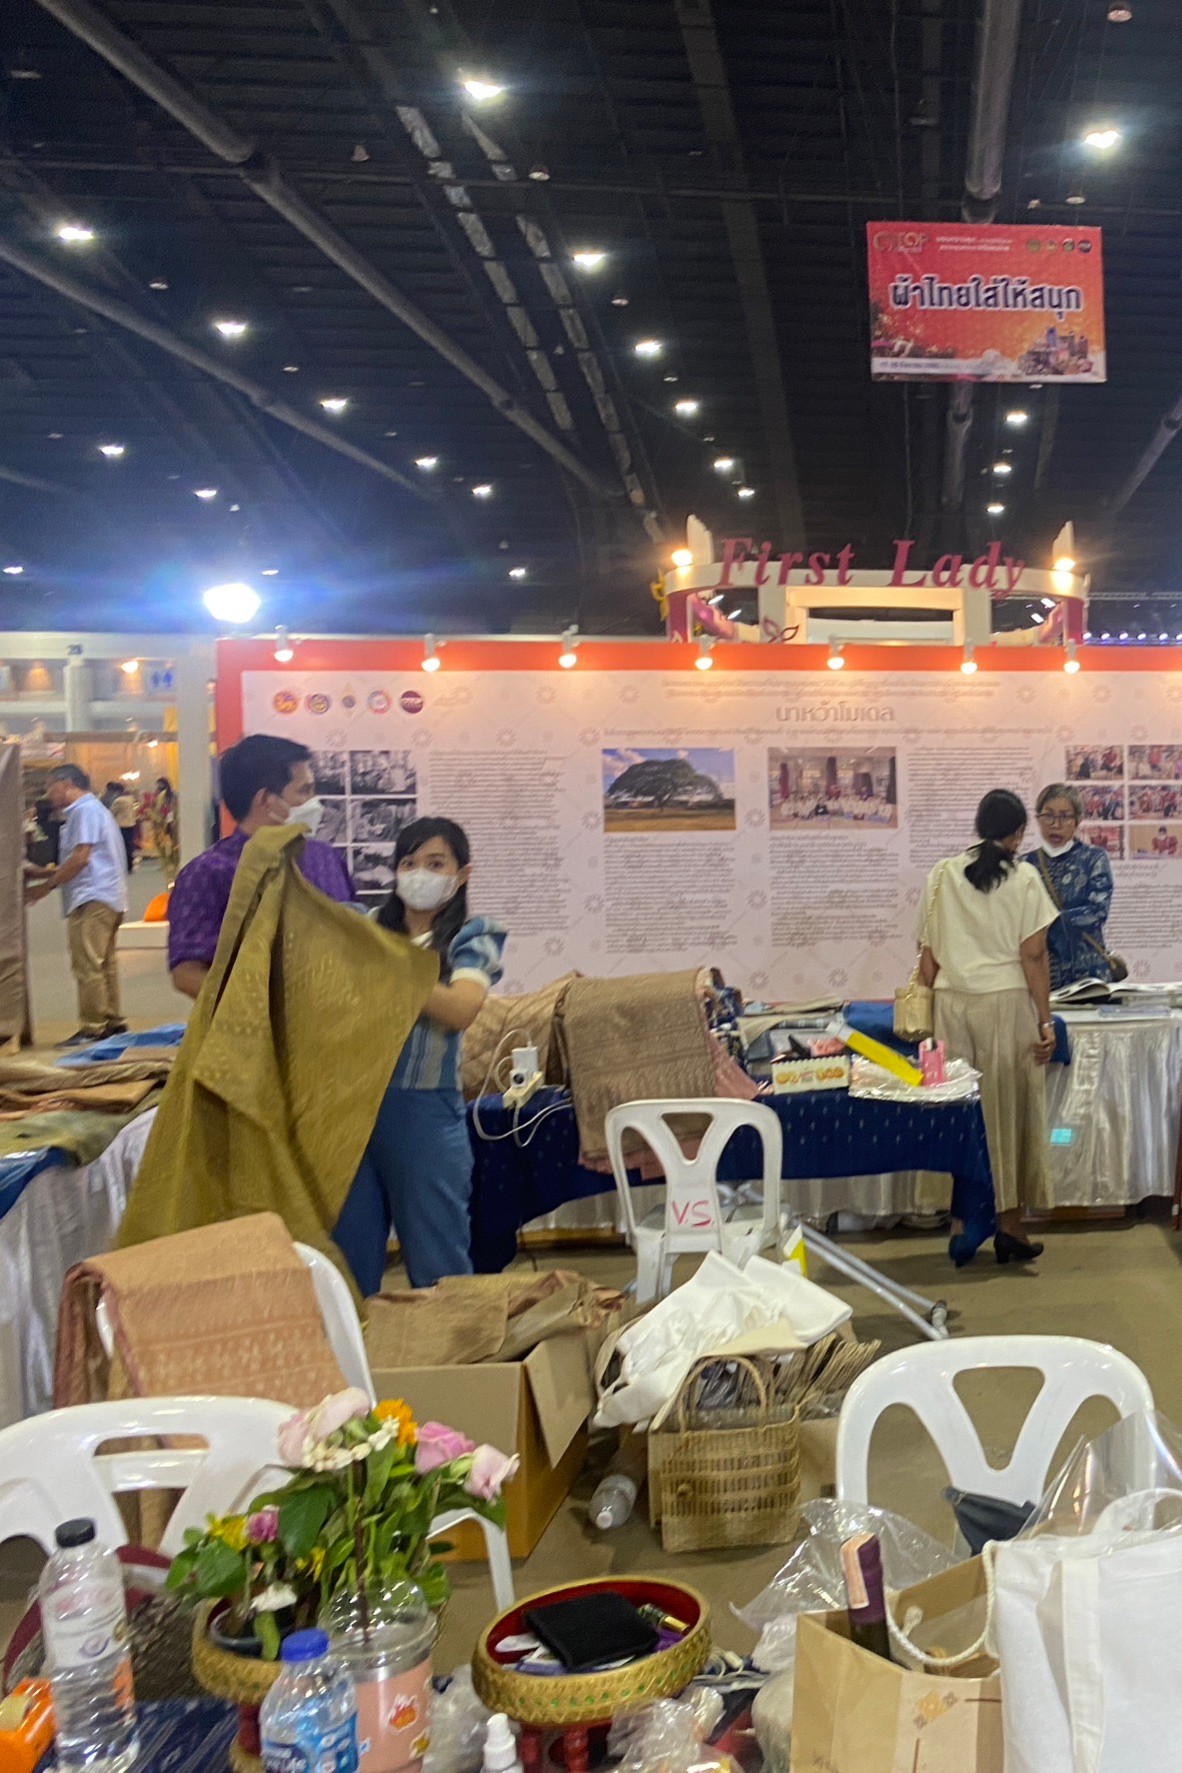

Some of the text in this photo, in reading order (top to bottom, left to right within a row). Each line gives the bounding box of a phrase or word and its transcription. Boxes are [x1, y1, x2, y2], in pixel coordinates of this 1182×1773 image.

[890, 273, 1083, 321] ผ้าไทยใส่ให้สนุก
[717, 538, 1027, 599] First Lady
[775, 700, 896, 723] นาหว้าโมเดล
